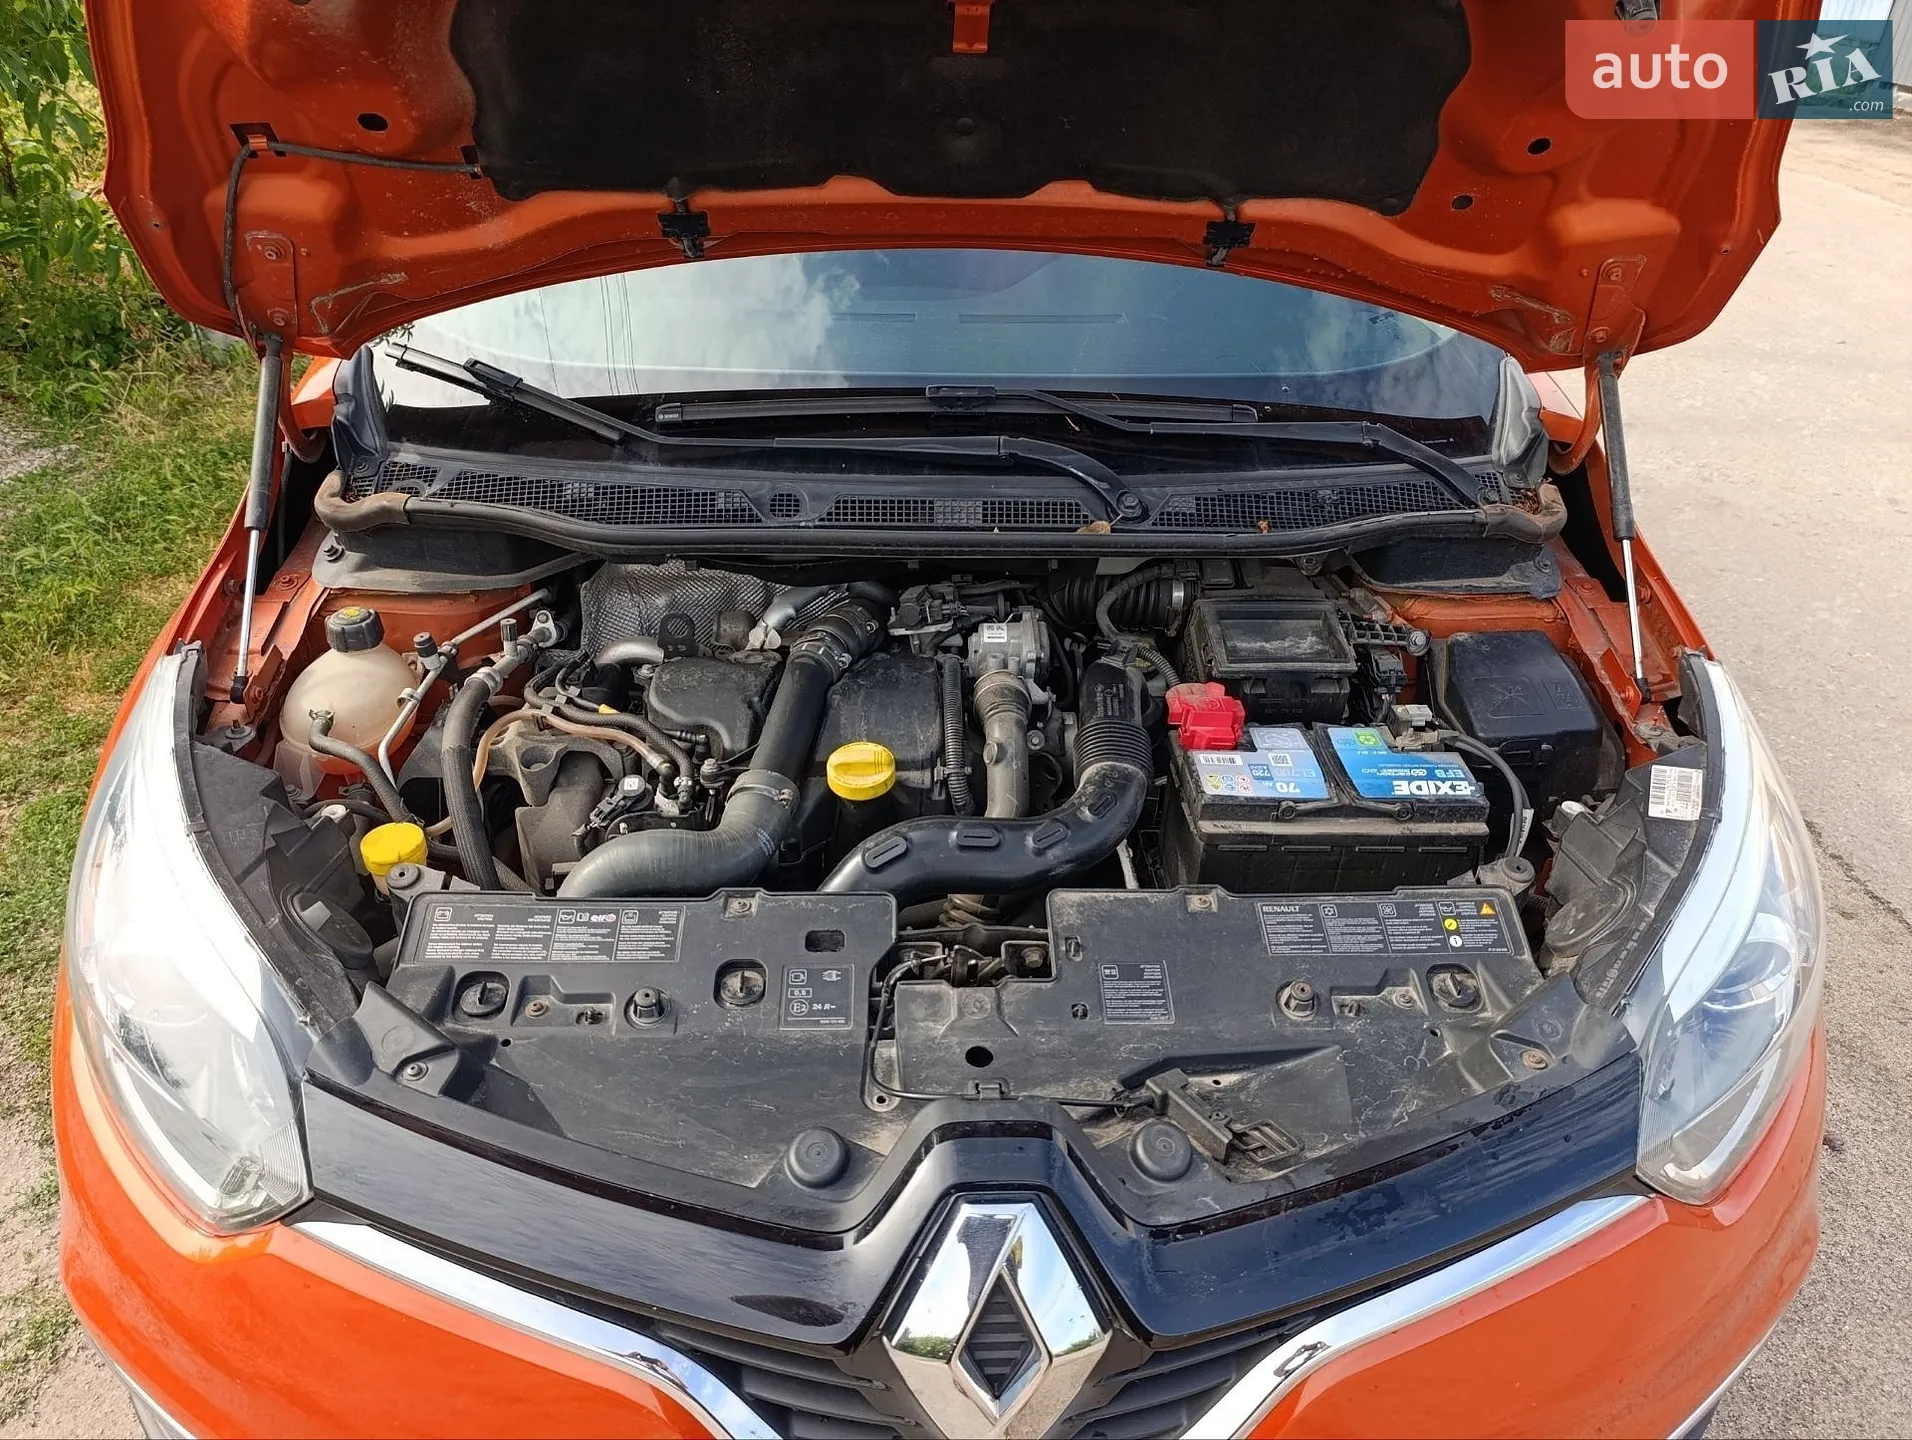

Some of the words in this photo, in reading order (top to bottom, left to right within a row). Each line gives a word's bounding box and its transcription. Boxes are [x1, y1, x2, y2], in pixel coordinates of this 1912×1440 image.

[1434, 769, 1465, 778] EFB
[1275, 782, 1301, 793] 70
[1392, 780, 1473, 795] EXIDE
[793, 1002, 807, 1013] E2
